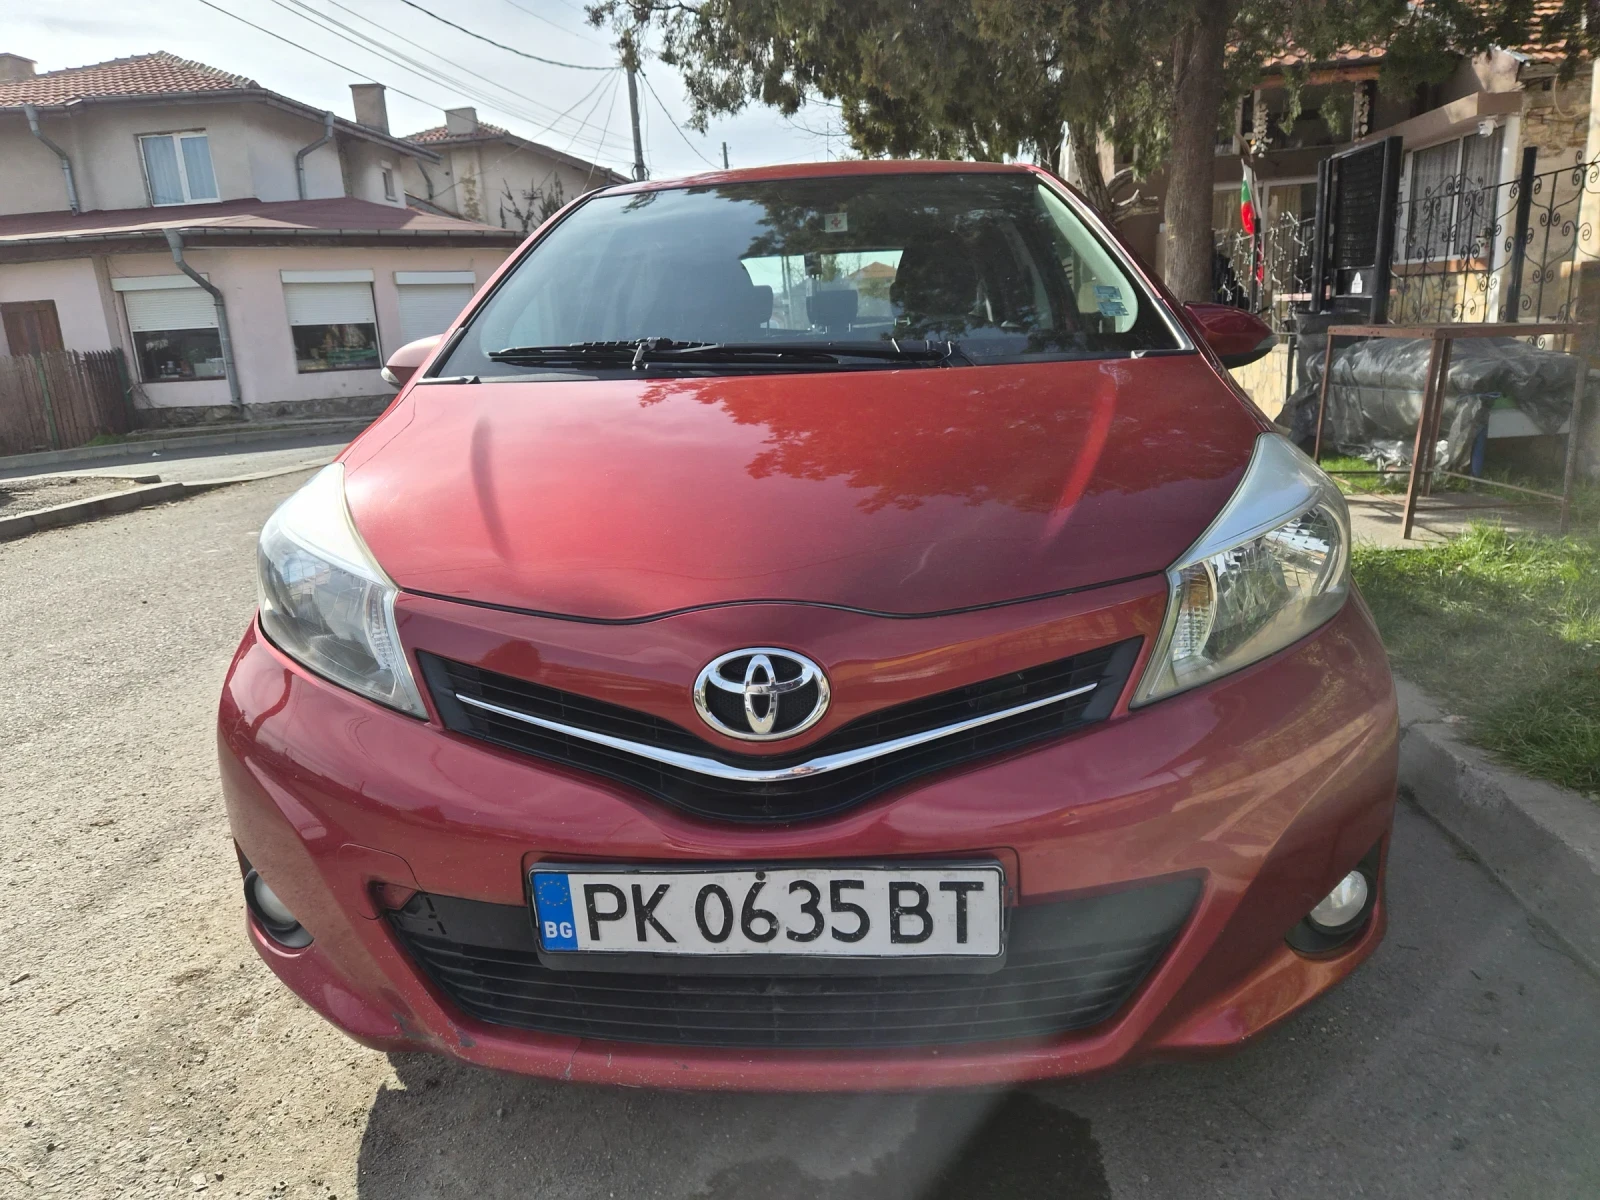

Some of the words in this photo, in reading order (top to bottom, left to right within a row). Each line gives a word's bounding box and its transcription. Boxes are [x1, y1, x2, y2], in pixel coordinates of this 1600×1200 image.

[544, 920, 573, 939] BG
[583, 883, 677, 943] PK
[695, 880, 871, 943] 0635
[890, 881, 984, 944] BT
